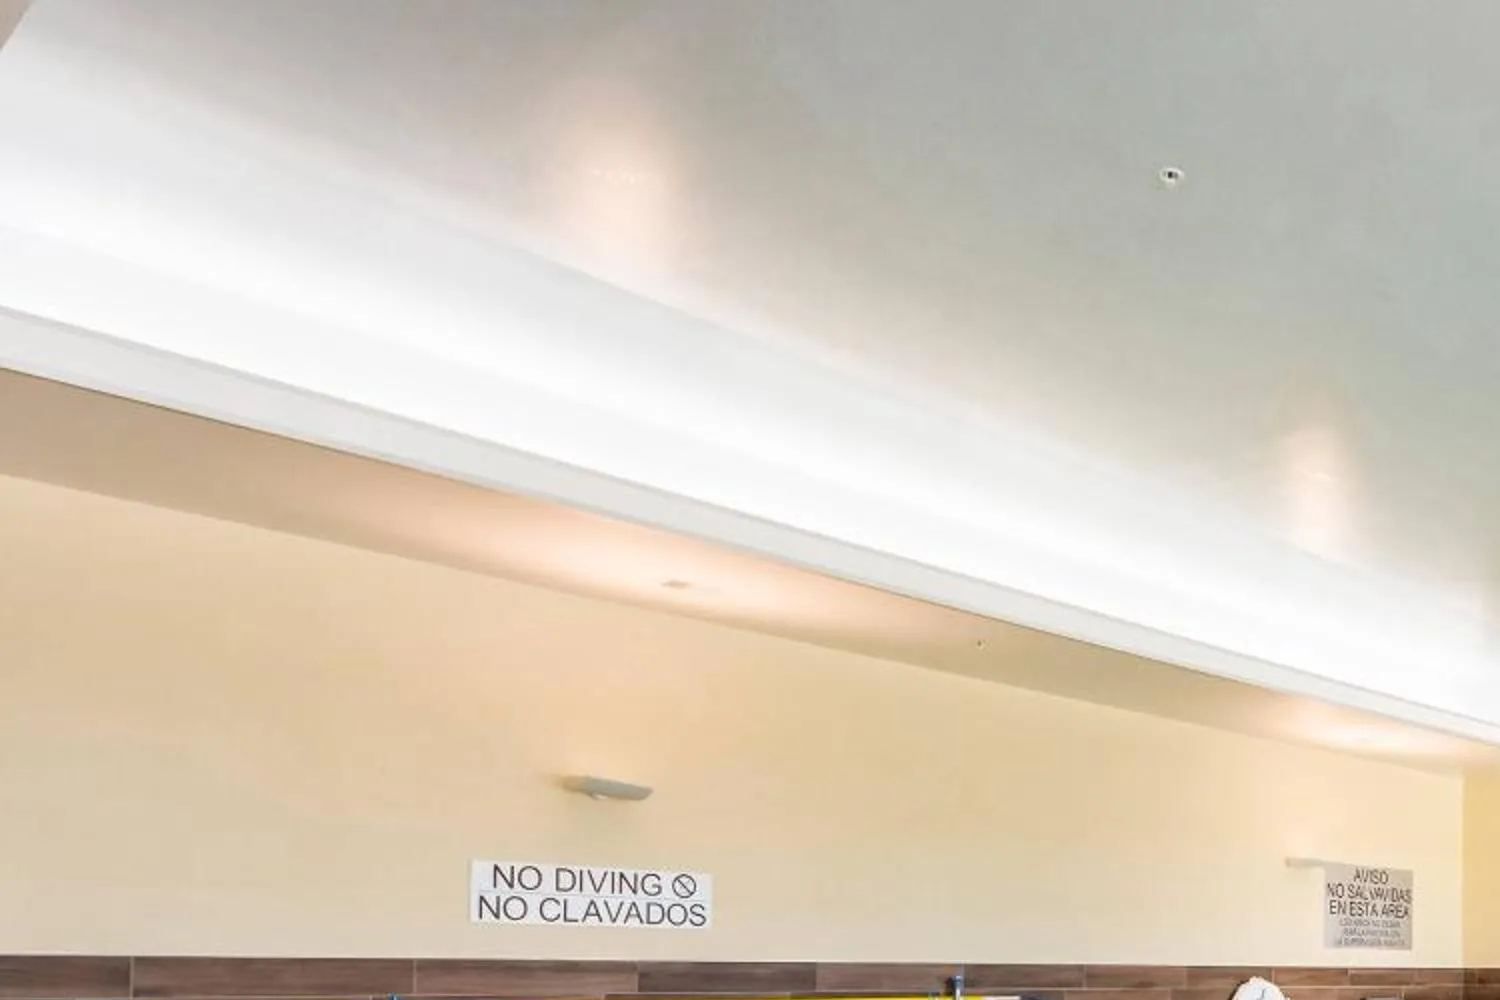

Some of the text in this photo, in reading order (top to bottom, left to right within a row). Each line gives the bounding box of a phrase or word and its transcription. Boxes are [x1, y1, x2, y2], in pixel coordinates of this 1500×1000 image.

[492, 863, 663, 897] NO DIVING
[1353, 867, 1389, 884] AVISO
[1327, 883, 1345, 898] NO
[478, 895, 707, 927] NO CLAVADOS
[1329, 900, 1347, 915] EN
[1349, 901, 1379, 917] ESTA
